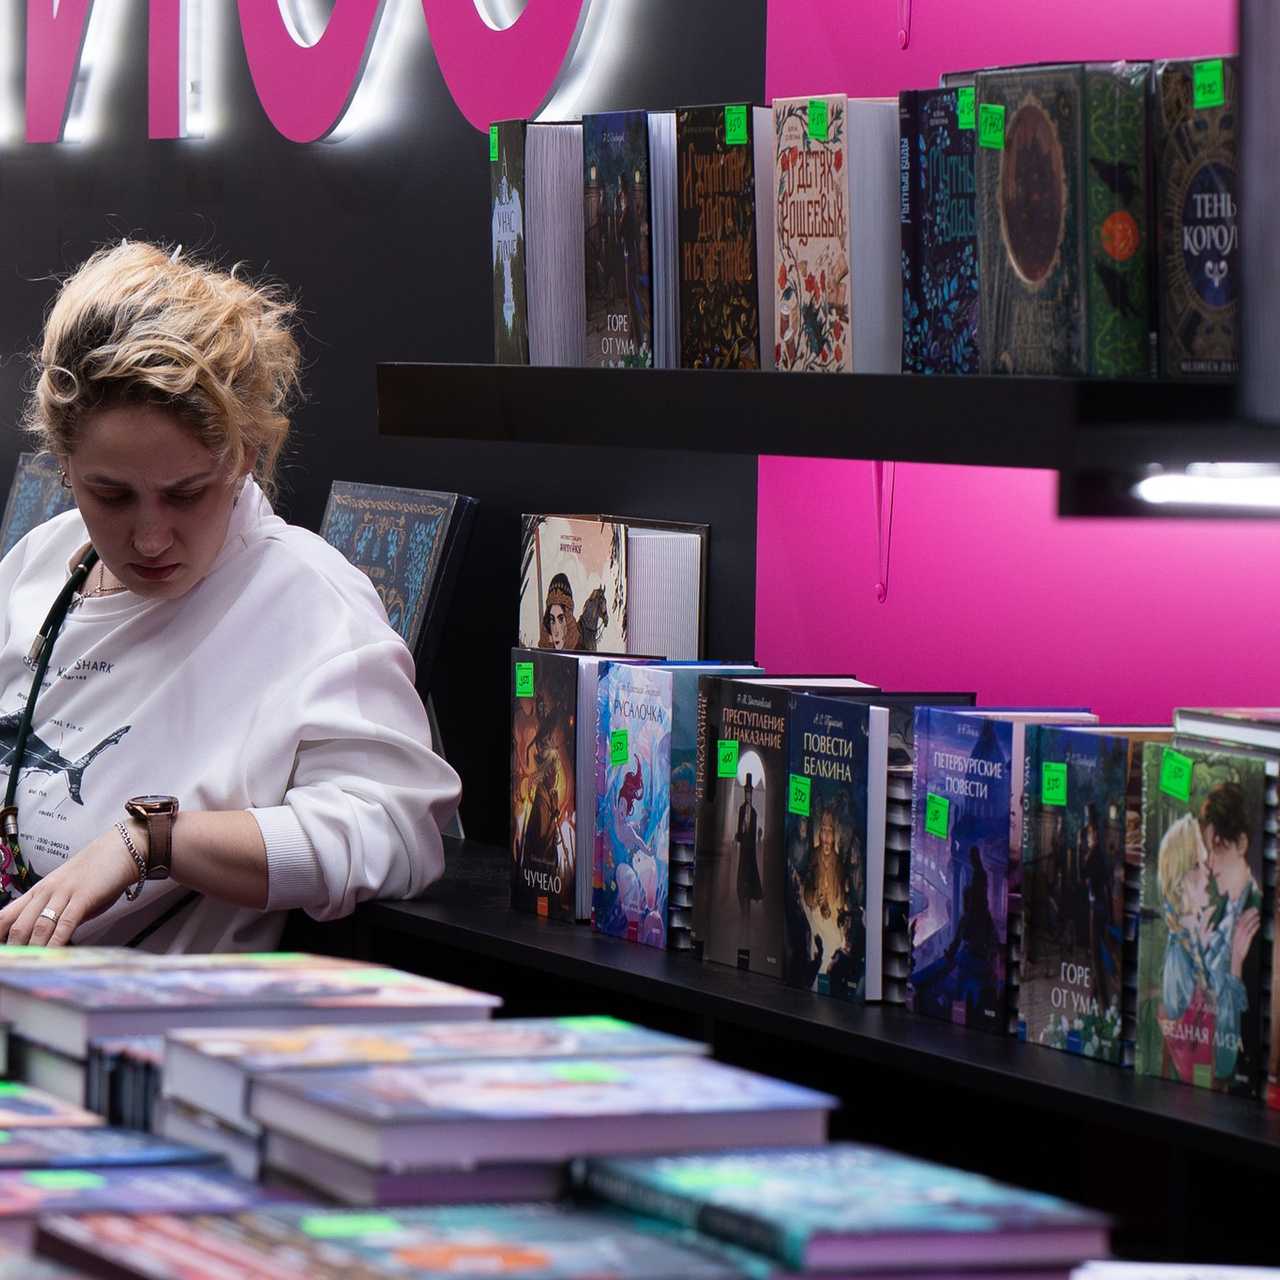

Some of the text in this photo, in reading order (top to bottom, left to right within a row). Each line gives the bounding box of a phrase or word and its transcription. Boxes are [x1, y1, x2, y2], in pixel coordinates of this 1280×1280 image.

[1192, 193, 1237, 219] ТЕНЬ
[607, 314, 628, 332] ГОРЕ
[601, 337, 636, 356] ОТ УМА
[74, 658, 115, 674] SHARK
[613, 699, 663, 724] РУСАЛОЧКА
[722, 707, 785, 733] ПРЕСТУПЛЕНИЕ
[724, 725, 782, 749] И НАКАЗАНИЕ
[803, 732, 853, 759] ПОВЕСТИ
[803, 755, 852, 783] БЕЛКИНА
[933, 751, 1003, 779] ПЕТЕРБУРГСКИЕ
[945, 776, 988, 799] ПОВЕСТИ
[523, 868, 562, 894] ЧУЧЕЛО
[1061, 961, 1091, 988] ГОРЕ
[1051, 986, 1098, 1017] ОТ УМА
[1162, 1018, 1209, 1044] БЕДНАЯ
